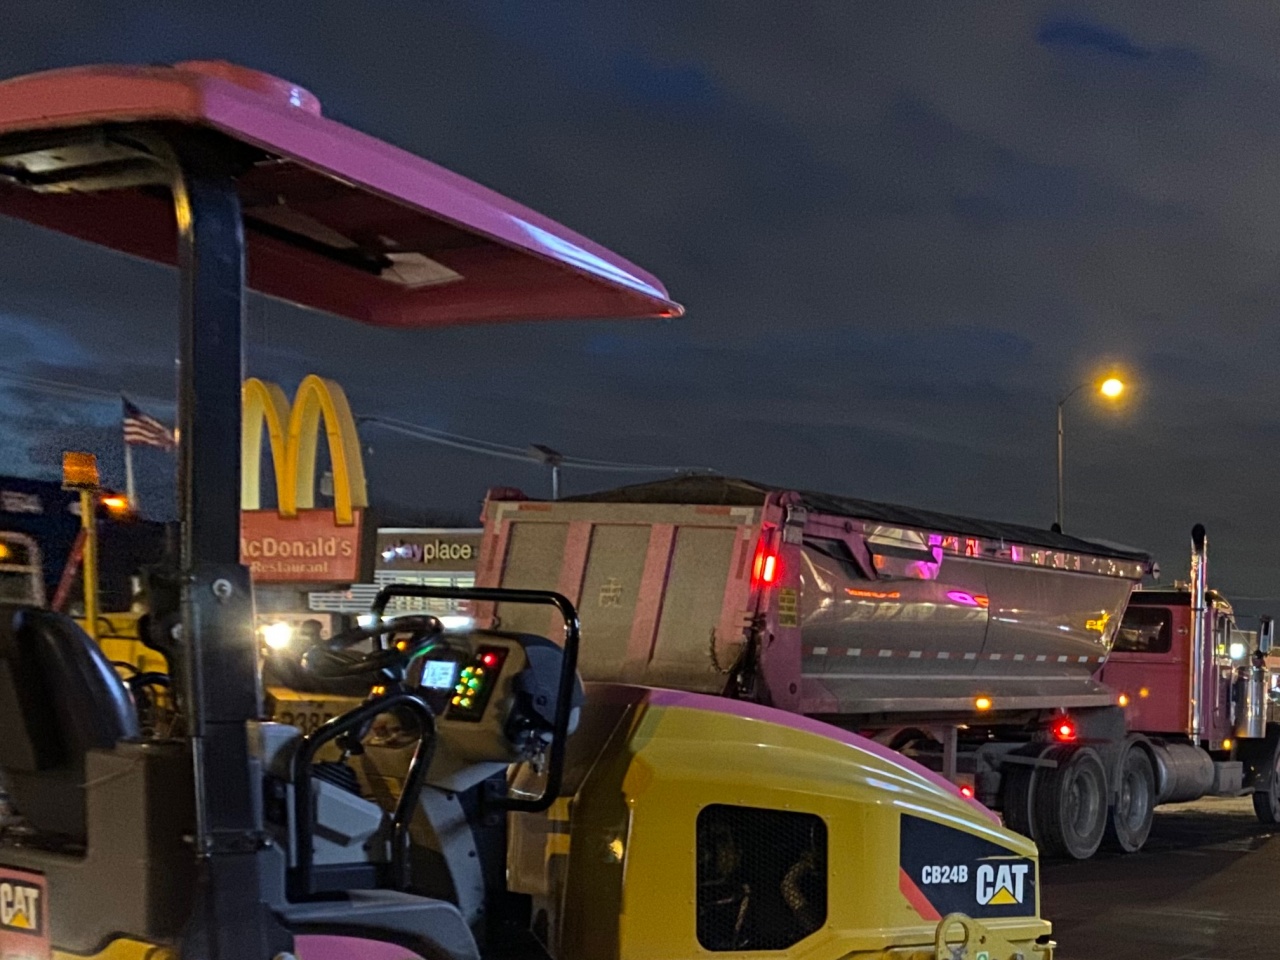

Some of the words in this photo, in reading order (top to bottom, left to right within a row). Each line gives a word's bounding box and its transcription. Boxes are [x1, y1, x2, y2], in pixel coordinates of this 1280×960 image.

[0, 882, 40, 930] CAT
[921, 865, 969, 885] CB24B
[975, 864, 1029, 906] CAT
